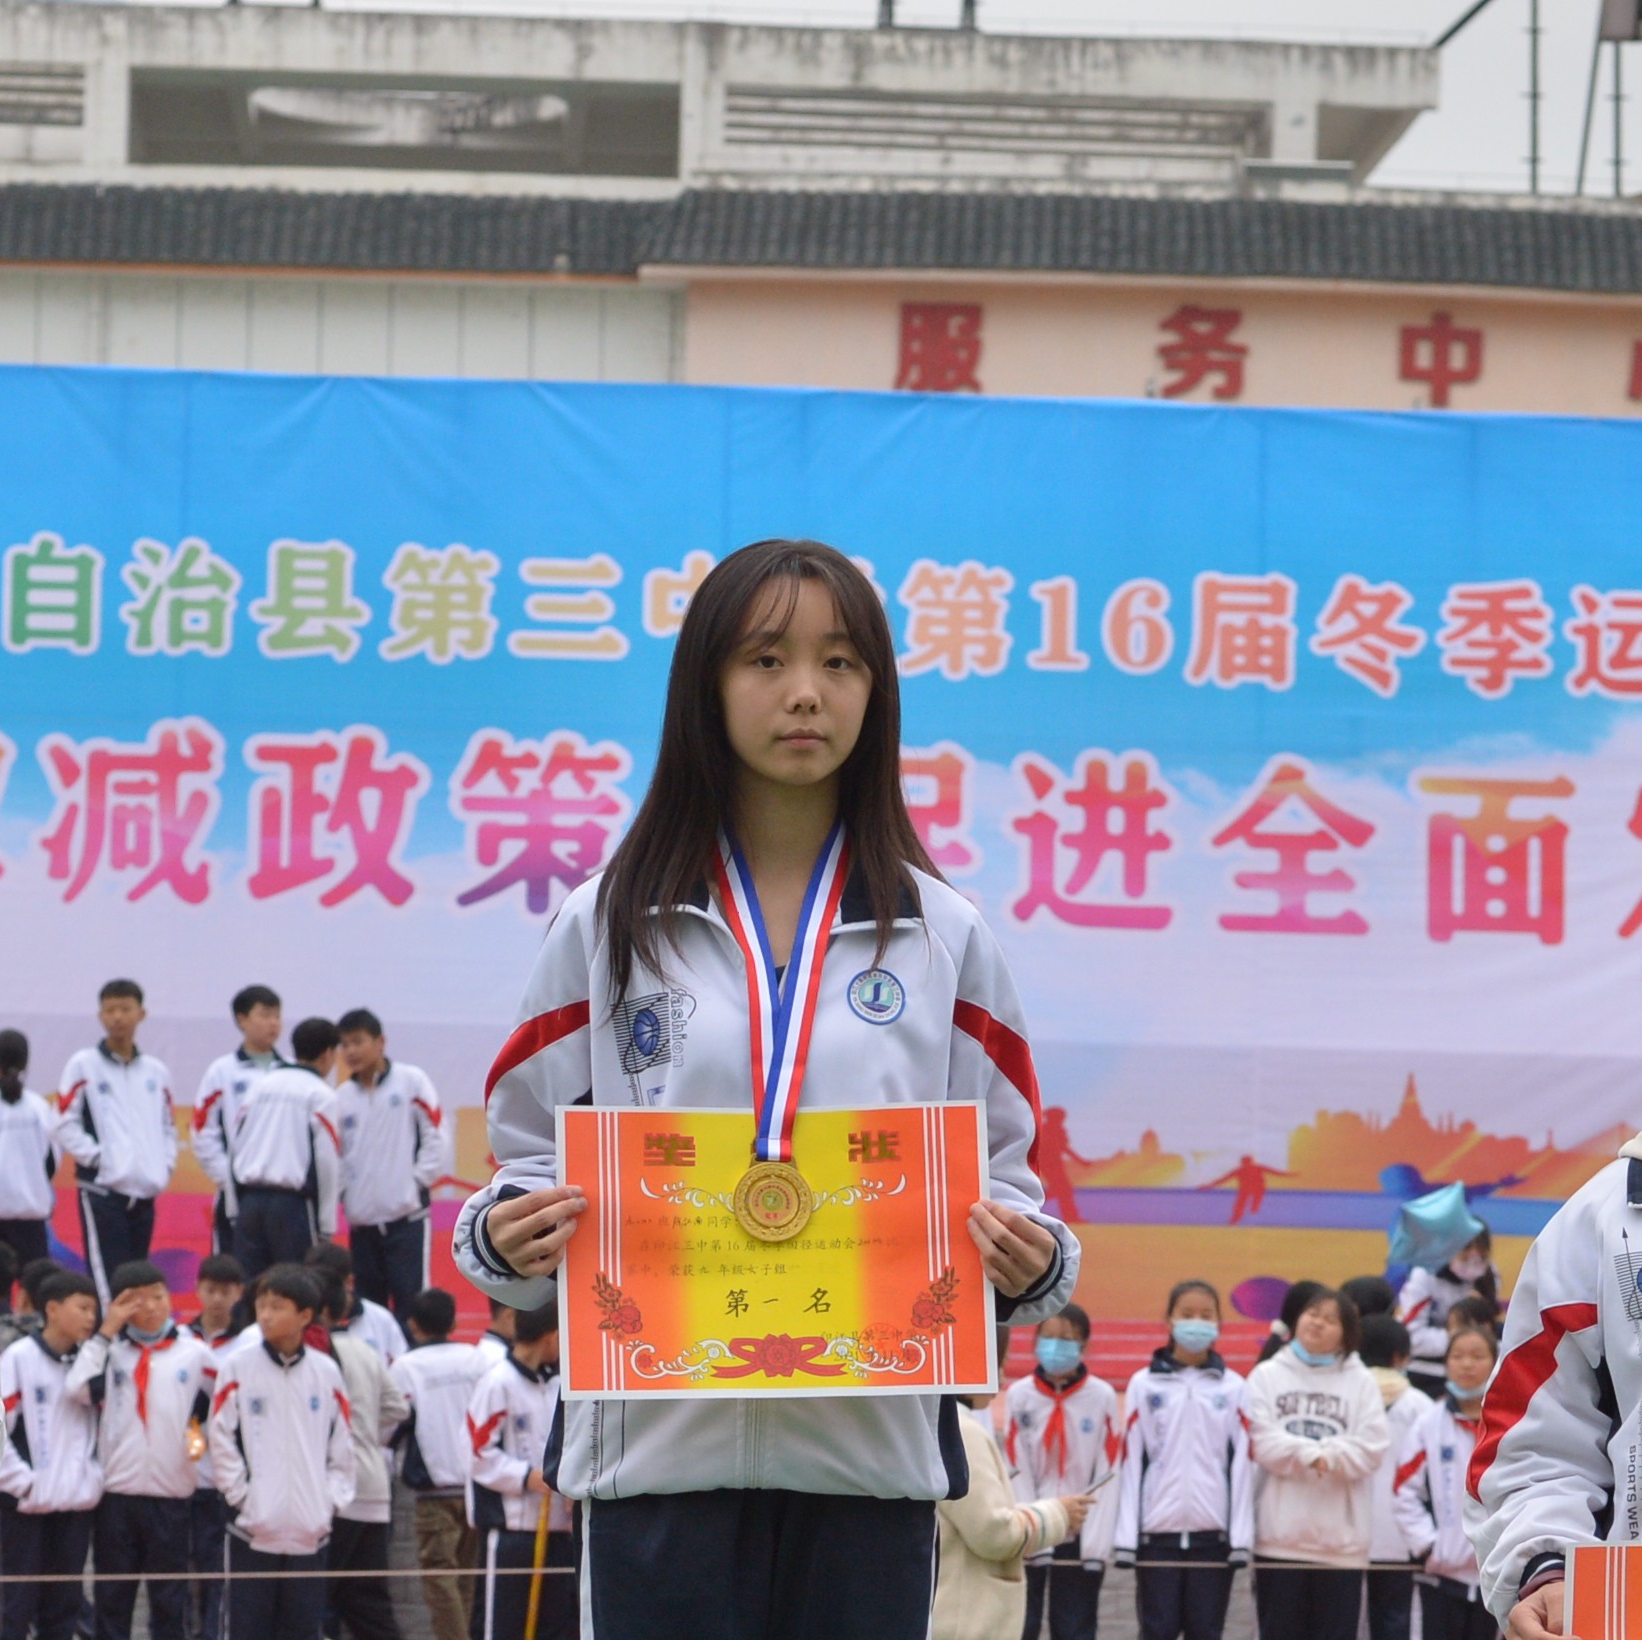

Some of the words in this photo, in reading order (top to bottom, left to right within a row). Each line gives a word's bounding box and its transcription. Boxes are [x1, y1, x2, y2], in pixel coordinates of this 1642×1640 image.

[670, 987, 693, 1068] fashion
[723, 1287, 833, 1318] 第一名
[1625, 1444, 1638, 1503] SPORTS
